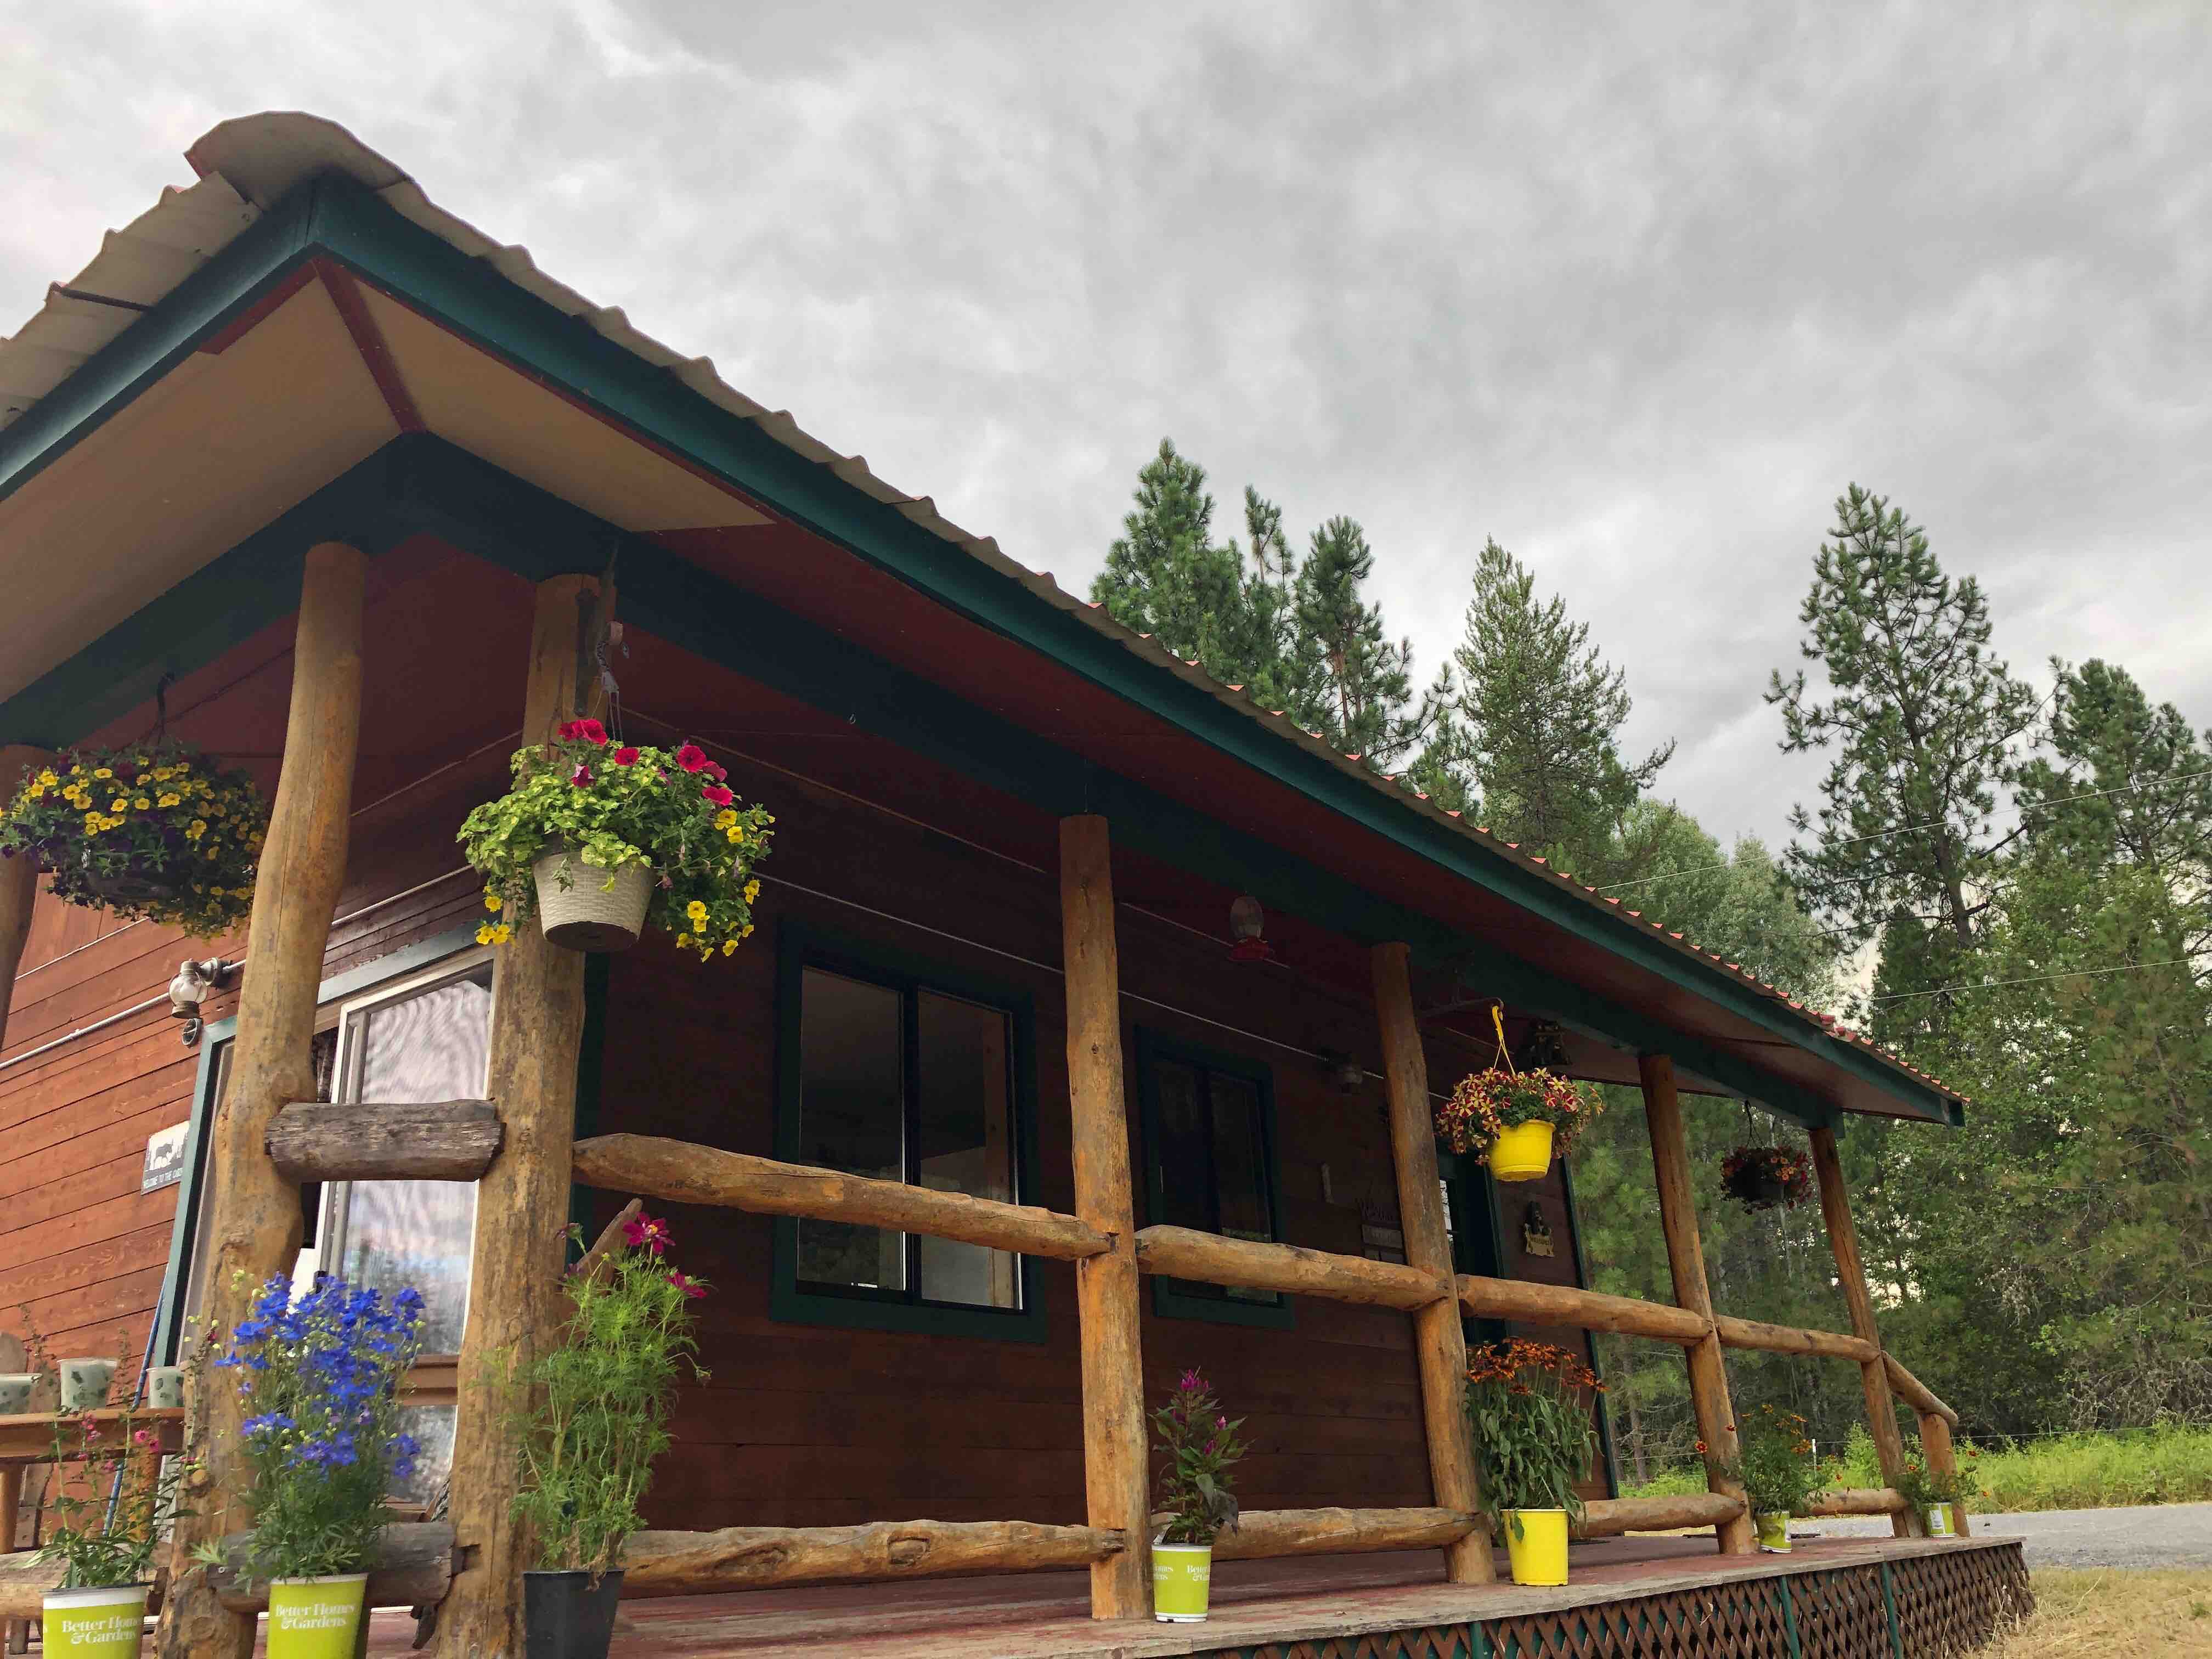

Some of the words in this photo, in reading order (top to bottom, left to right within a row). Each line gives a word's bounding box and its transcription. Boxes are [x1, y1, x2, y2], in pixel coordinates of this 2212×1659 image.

[276, 1604, 312, 1616] Better
[313, 1603, 355, 1616] Homes
[61, 1620, 105, 1633] Better
